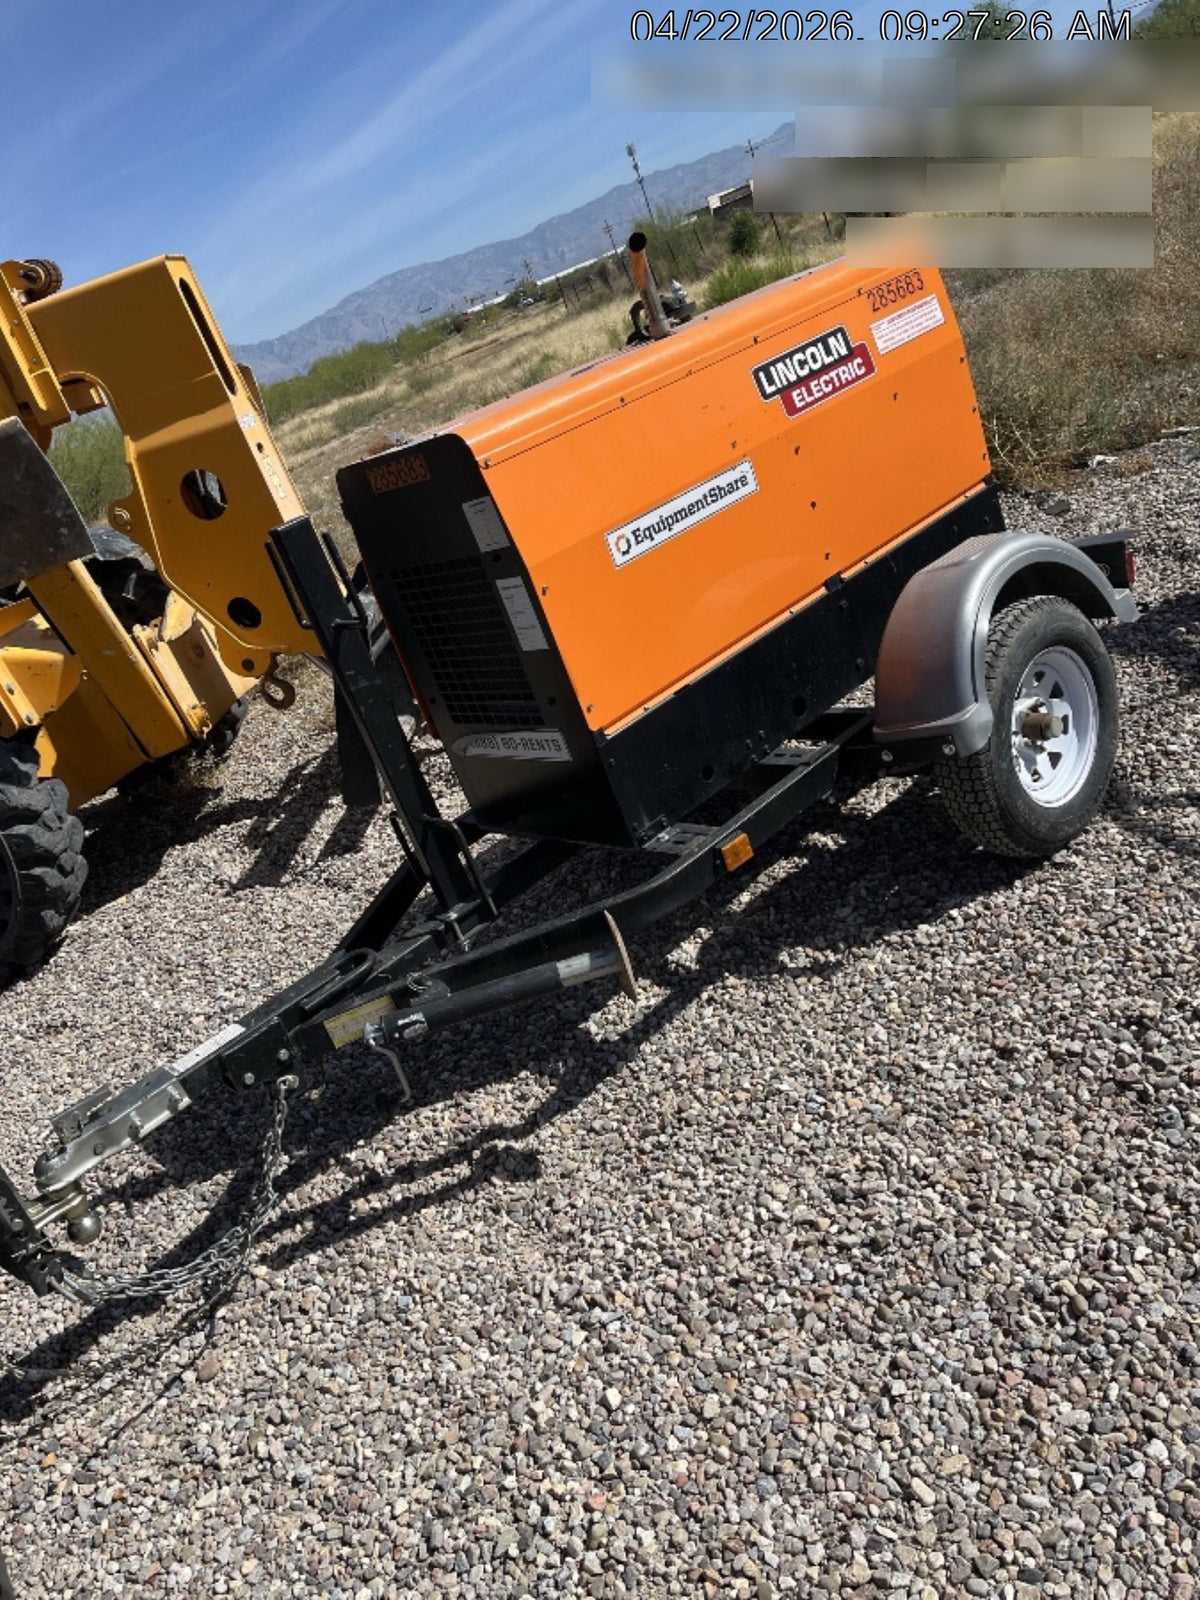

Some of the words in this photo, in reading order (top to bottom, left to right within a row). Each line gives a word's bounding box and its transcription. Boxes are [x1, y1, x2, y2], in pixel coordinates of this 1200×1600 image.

[866, 270, 925, 313] 285683
[758, 332, 849, 395] LINCOLN
[791, 356, 867, 408] ELECTRIC
[631, 474, 749, 547] EquipmentShare
